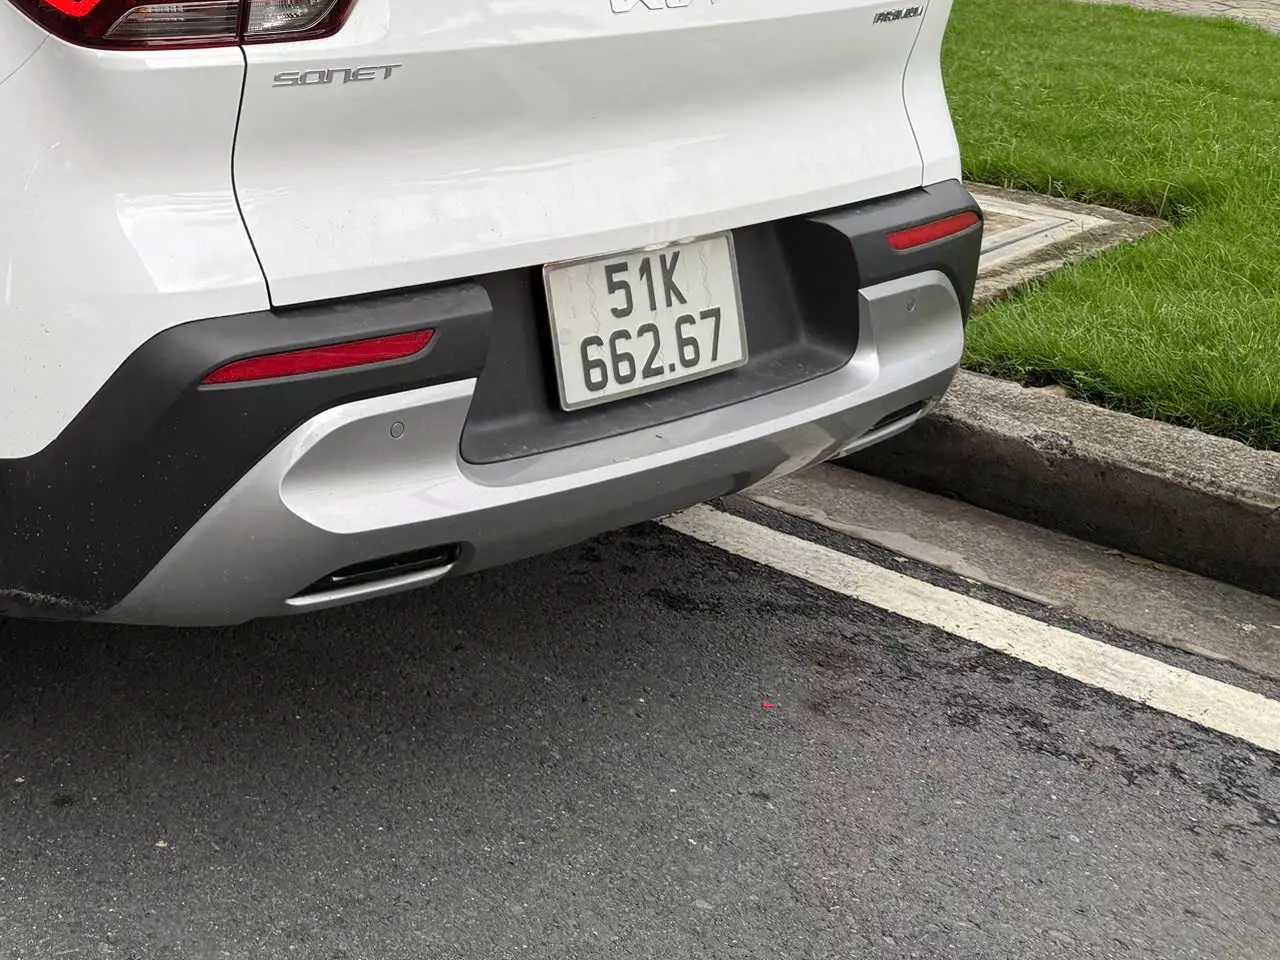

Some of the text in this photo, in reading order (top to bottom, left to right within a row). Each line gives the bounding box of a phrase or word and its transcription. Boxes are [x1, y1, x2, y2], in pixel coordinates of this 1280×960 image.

[271, 62, 402, 88] SONET
[604, 250, 688, 319] 51K
[580, 307, 721, 392] 662.67
